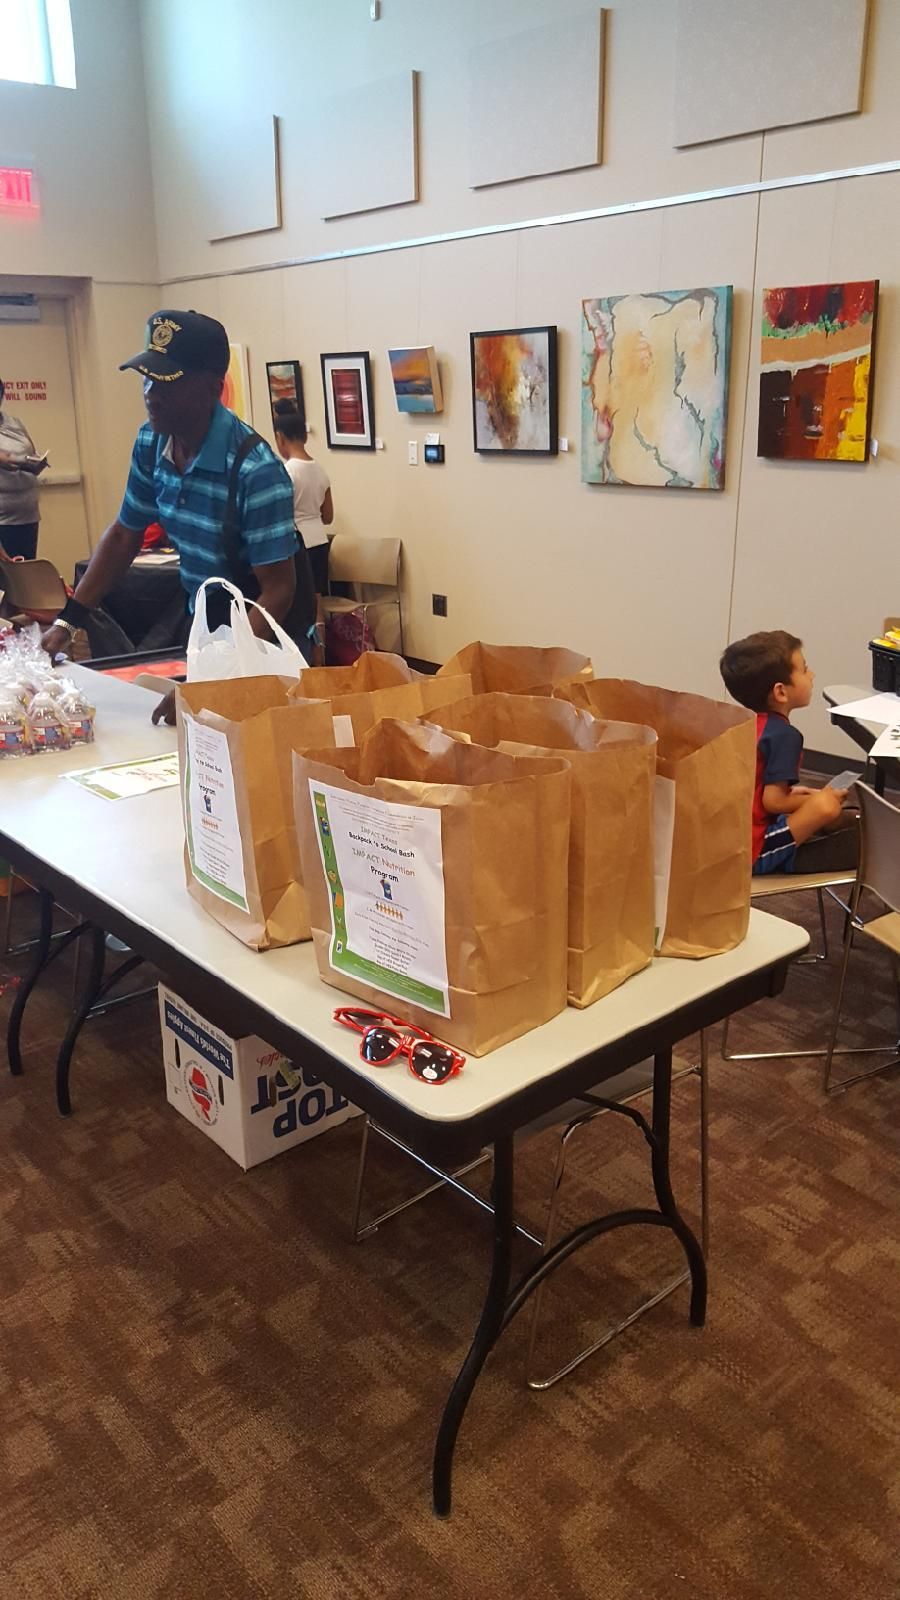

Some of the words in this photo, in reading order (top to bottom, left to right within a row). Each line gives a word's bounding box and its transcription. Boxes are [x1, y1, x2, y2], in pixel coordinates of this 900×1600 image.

[16, 381, 29, 390] EXIT
[31, 381, 46, 390] ONLY
[5, 393, 21, 401] WILL
[25, 393, 47, 401] SOUND
[348, 831, 373, 846] Backpack
[380, 843, 398, 855] School
[398, 849, 415, 859] Bash
[352, 847, 380, 863] IMPACT
[381, 857, 416, 877] Nutrition
[370, 865, 399, 883] Program
[167, 1009, 184, 1031] Apples
[183, 1024, 201, 1044] Finest
[220, 1052, 231, 1070] The
[273, 1086, 349, 1138] TOP
